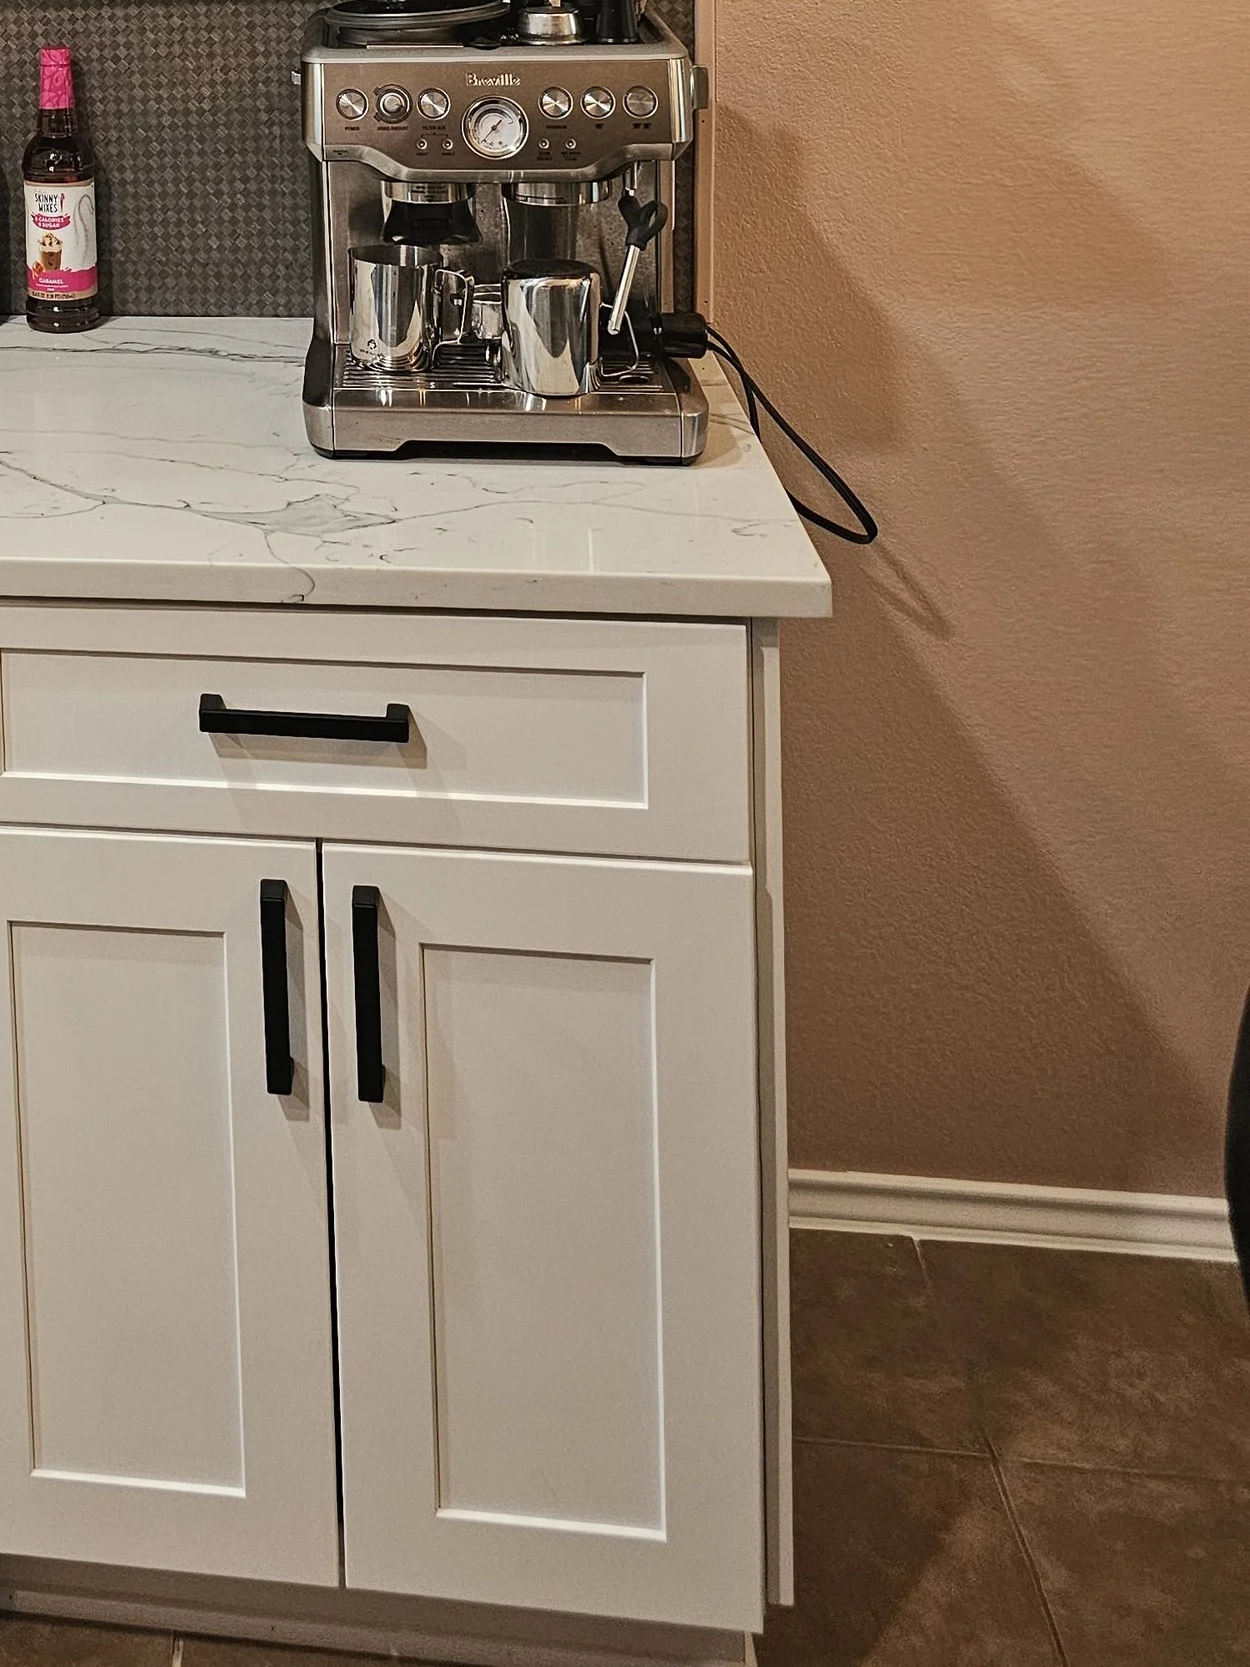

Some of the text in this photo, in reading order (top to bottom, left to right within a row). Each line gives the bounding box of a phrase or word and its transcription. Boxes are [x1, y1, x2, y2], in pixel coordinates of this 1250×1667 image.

[466, 72, 521, 87] Breville
[35, 193, 58, 203] SKINNY
[38, 203, 58, 213] MIXES
